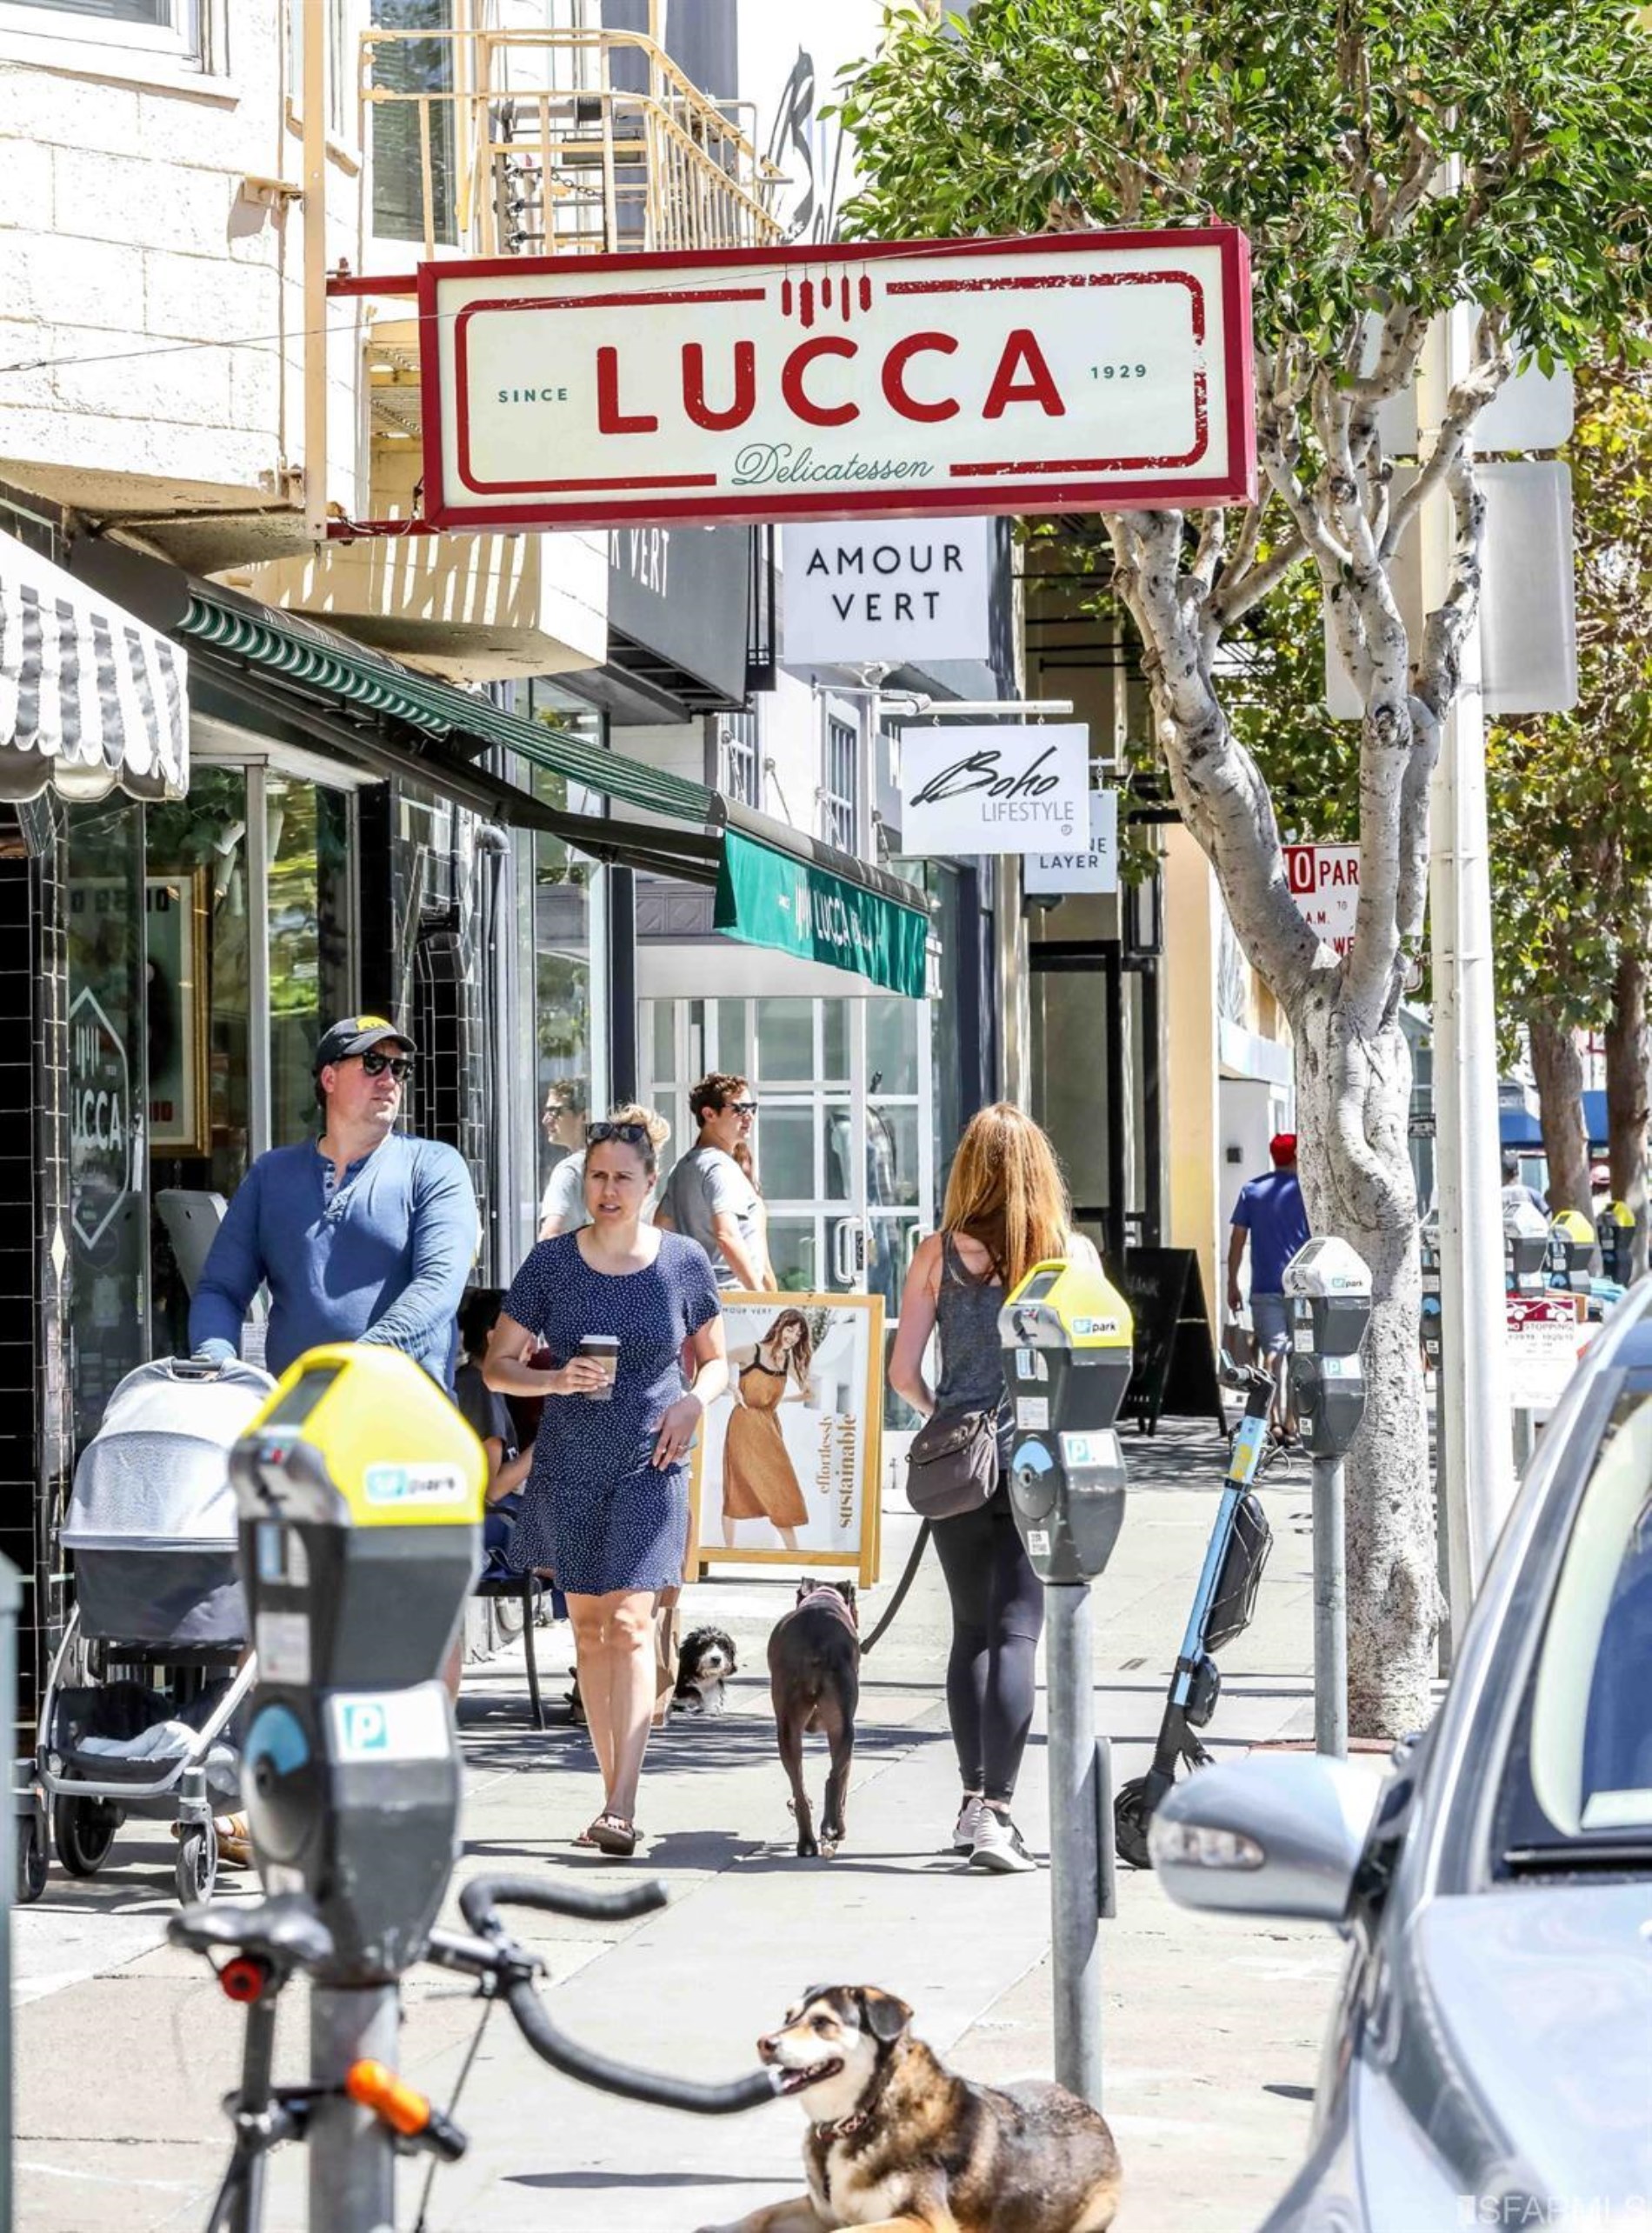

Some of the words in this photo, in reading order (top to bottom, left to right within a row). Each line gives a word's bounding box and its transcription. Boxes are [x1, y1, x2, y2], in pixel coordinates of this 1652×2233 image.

[597, 329, 1065, 434] LUCCA
[1090, 363, 1147, 380] 1929
[497, 387, 570, 403] SINCE
[732, 443, 935, 485] Delicatessen
[806, 544, 964, 576] AMOUR
[832, 591, 941, 622] VERT
[909, 745, 1060, 807] Boho
[982, 801, 1074, 822] LIFESTYLE
[1039, 854, 1099, 870] LAYER
[835, 1414, 856, 1529] sustainable
